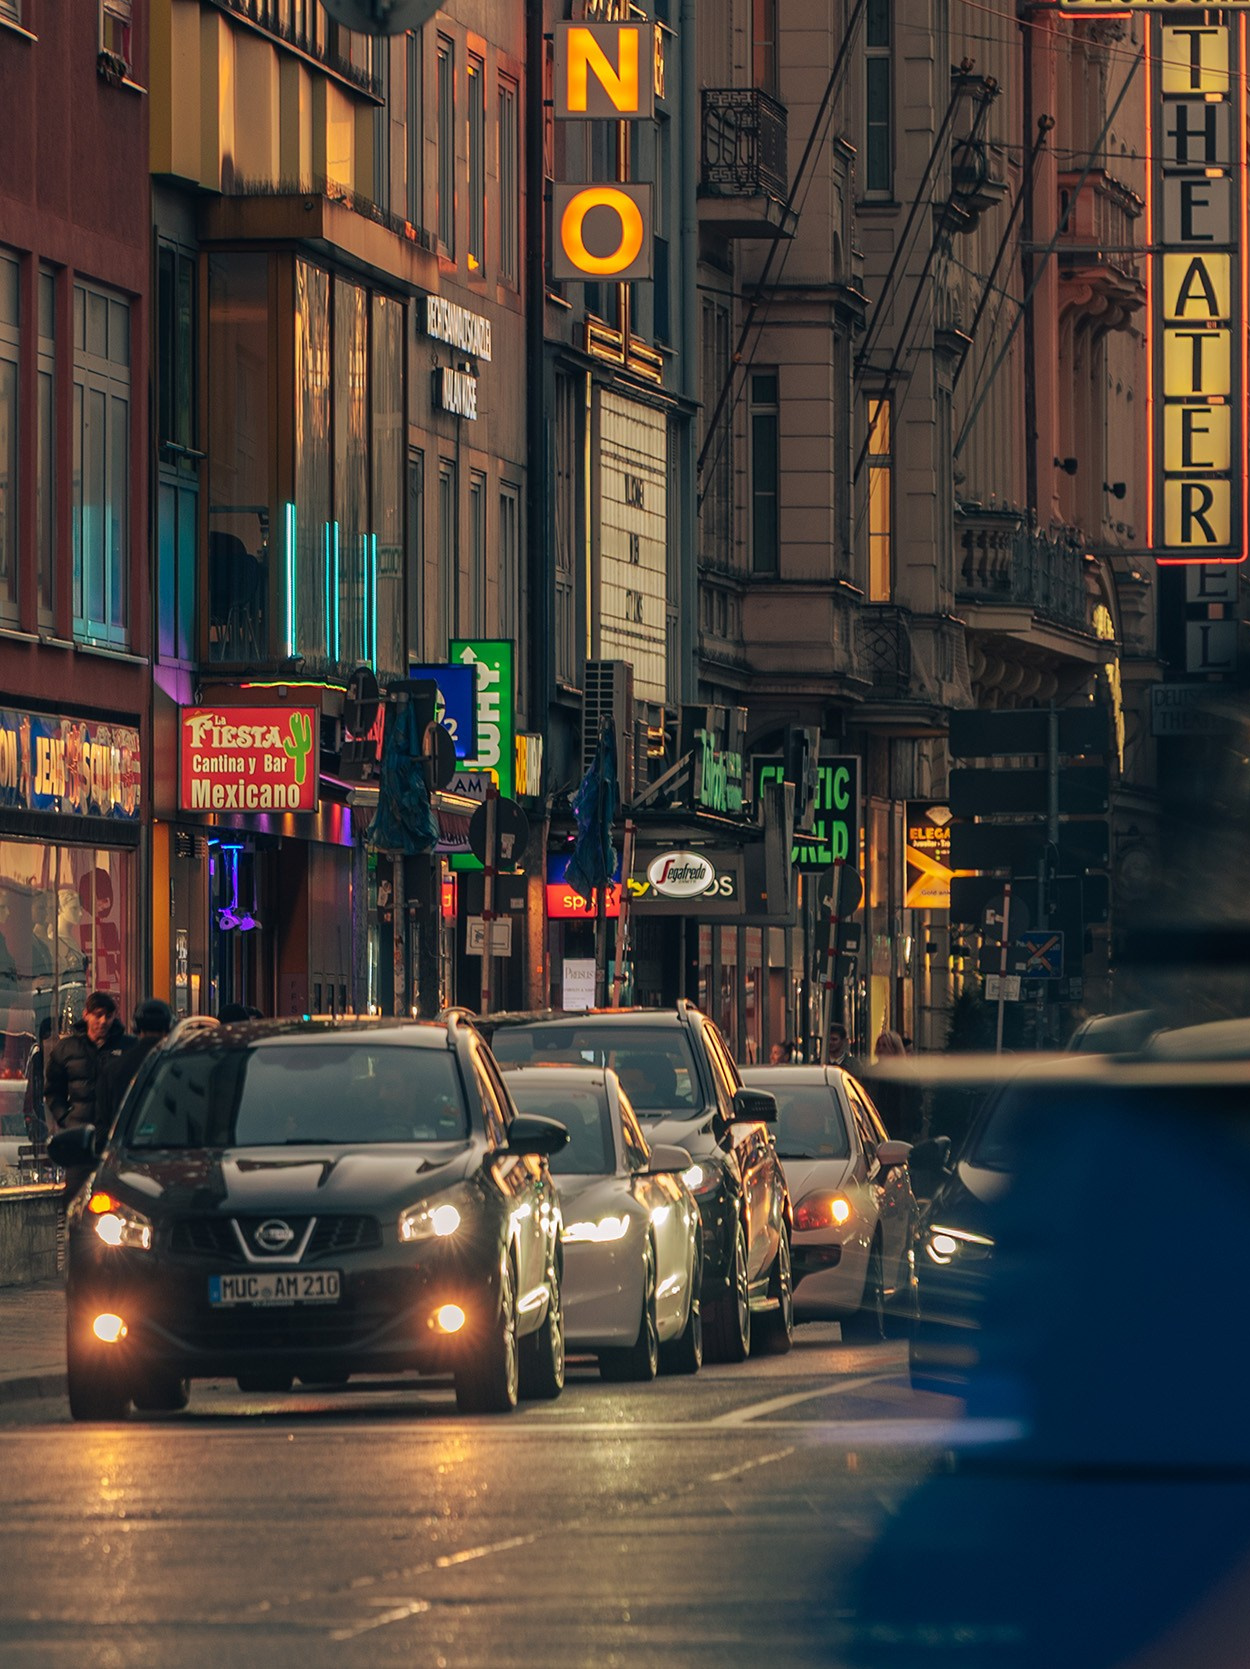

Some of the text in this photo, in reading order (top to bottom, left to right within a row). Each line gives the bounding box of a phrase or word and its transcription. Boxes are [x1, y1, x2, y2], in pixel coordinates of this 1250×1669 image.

[1167, 29, 1219, 543] THEATER
[214, 715, 226, 725] La
[193, 754, 287, 775] Cantina y Bar
[191, 779, 300, 808] Mexicano
[656, 859, 706, 885] Segafredo
[223, 1275, 338, 1299] MUC AM 210
